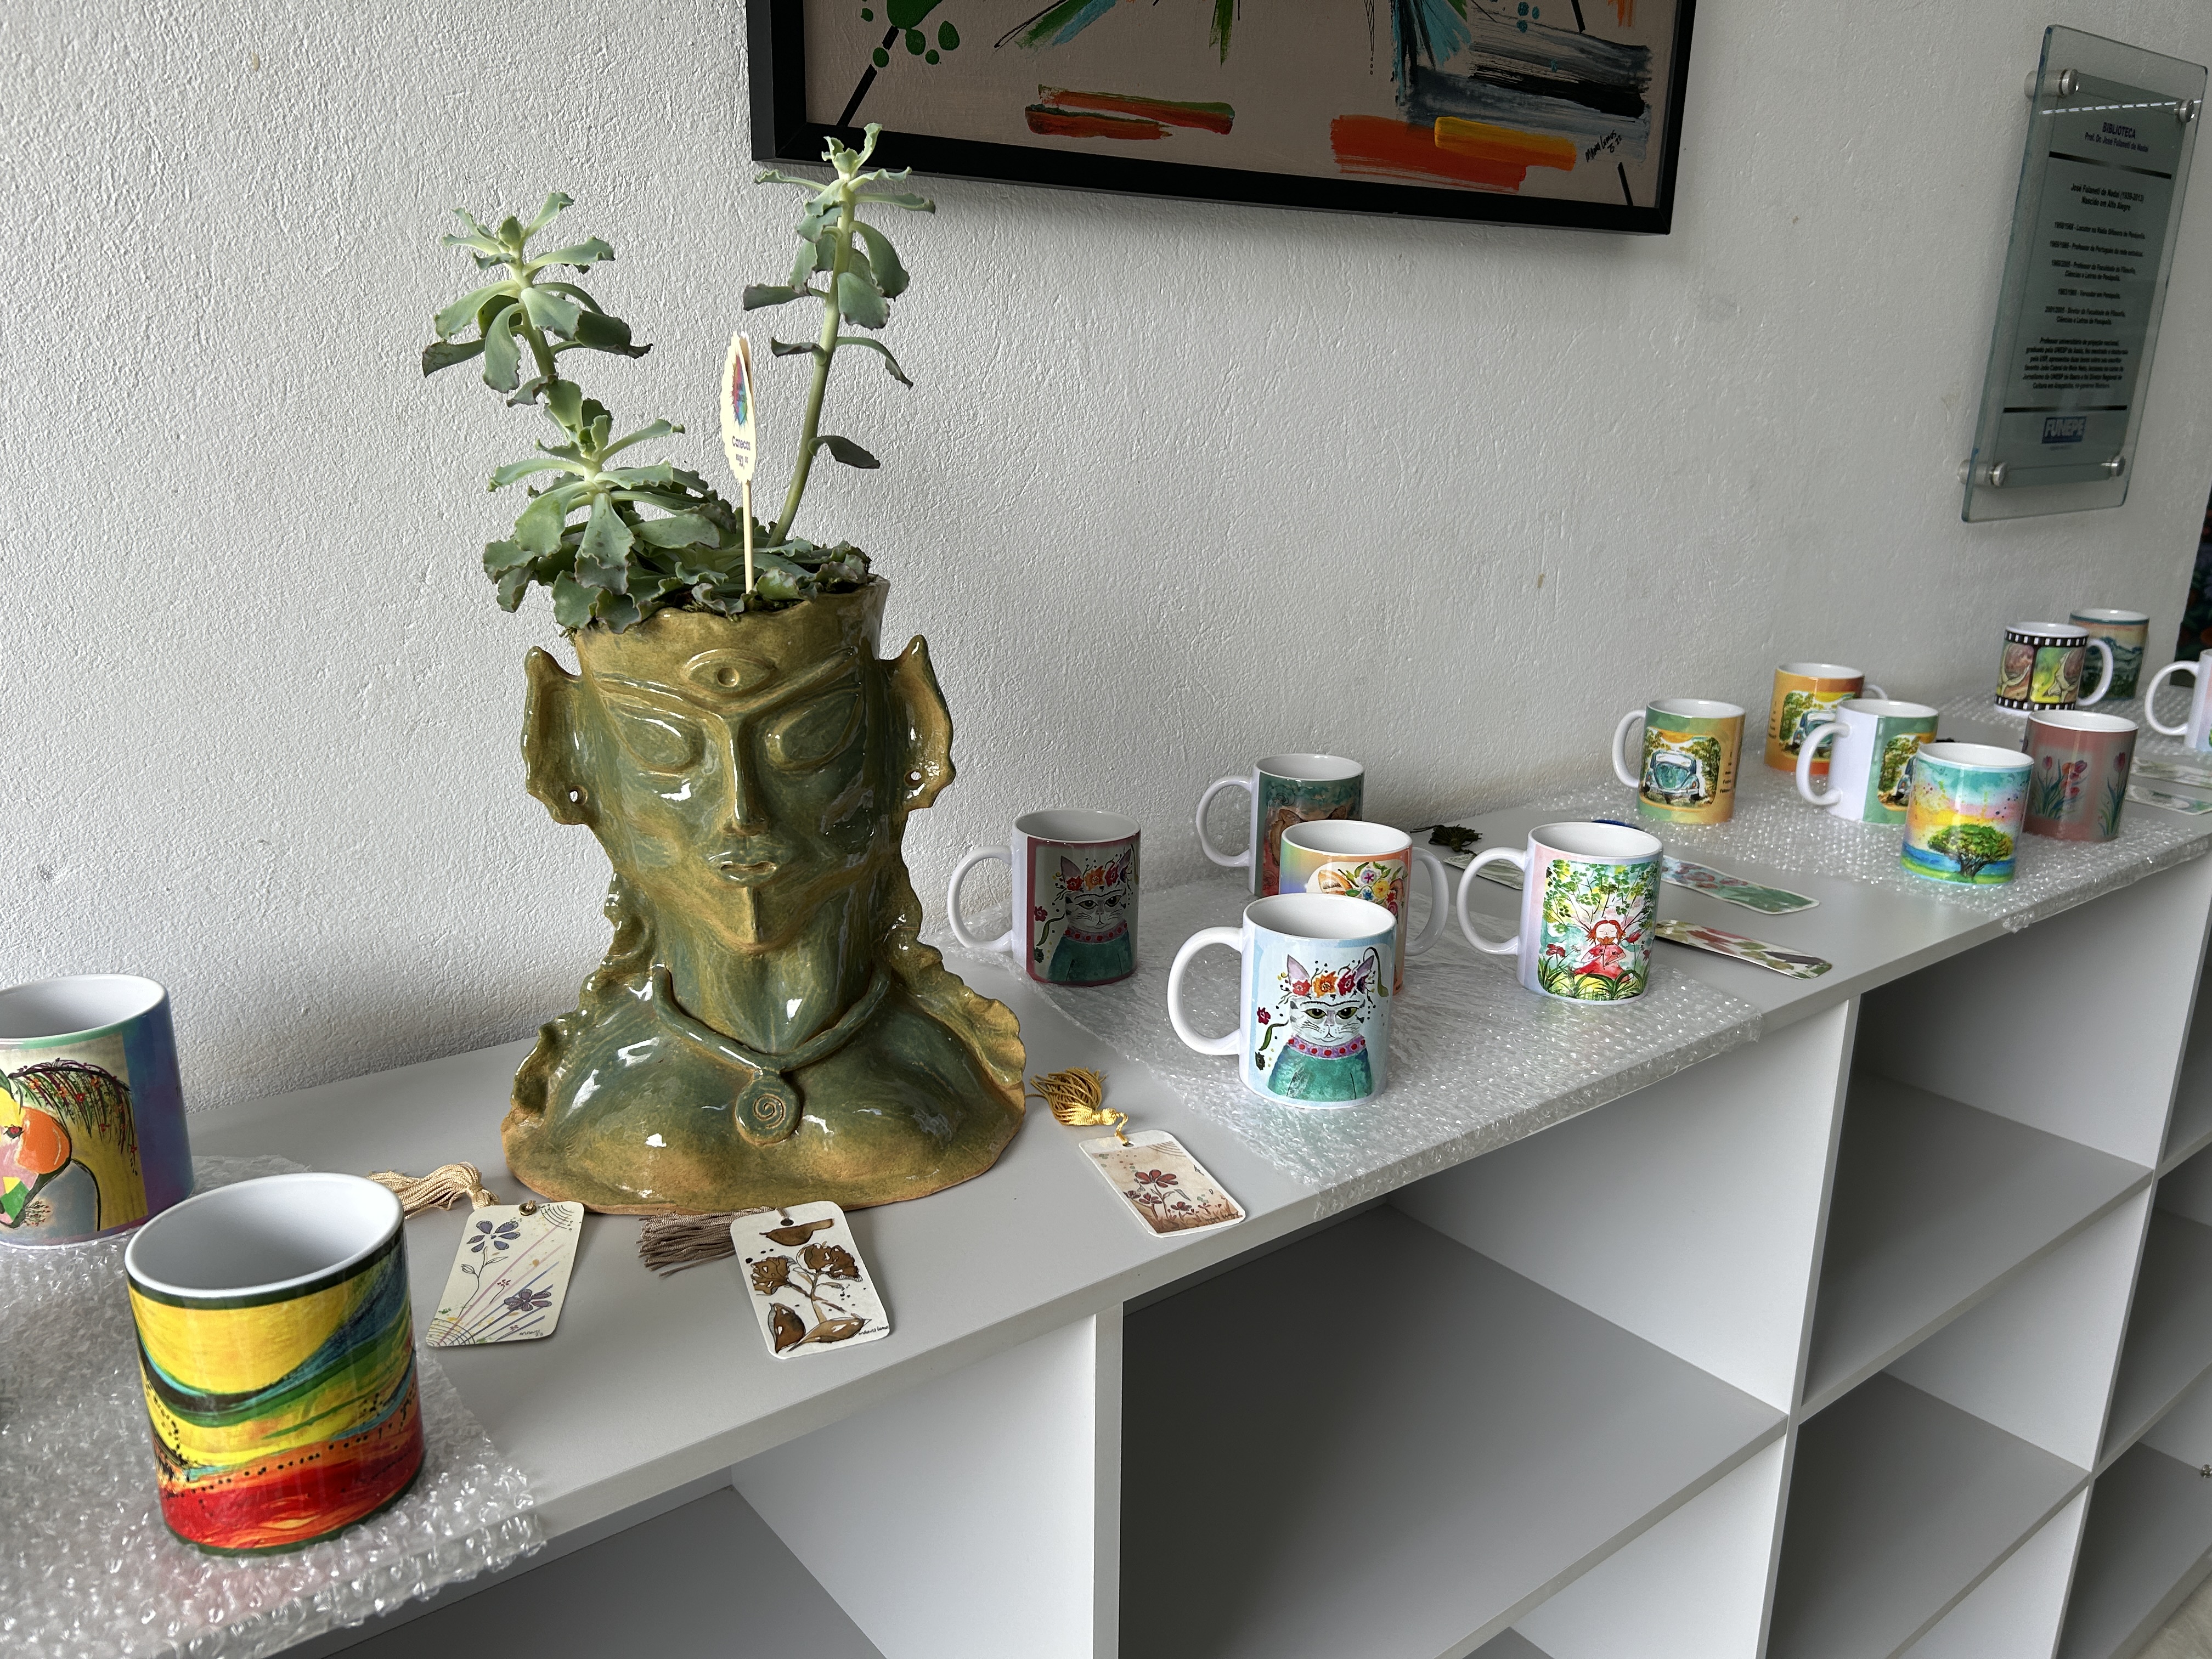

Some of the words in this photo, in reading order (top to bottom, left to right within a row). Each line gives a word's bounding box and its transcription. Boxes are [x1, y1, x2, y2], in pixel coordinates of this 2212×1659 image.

[2085, 132, 2095, 141] Prof.
[2102, 122, 2136, 139] BIBLIOTECA
[2044, 418, 2085, 438] FUNEPE
